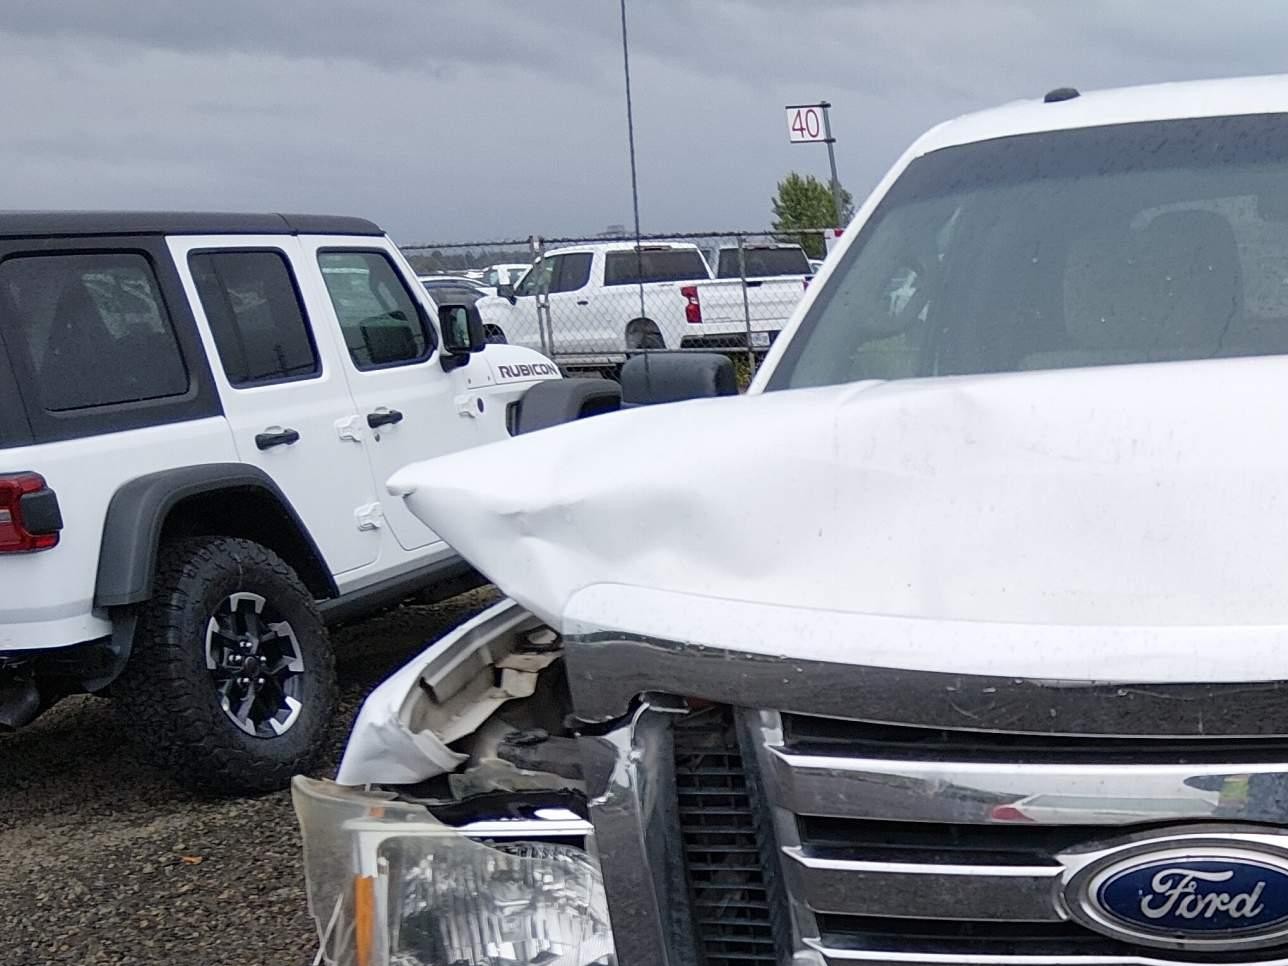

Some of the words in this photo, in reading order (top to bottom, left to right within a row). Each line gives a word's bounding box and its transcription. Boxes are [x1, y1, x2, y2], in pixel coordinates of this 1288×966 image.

[792, 109, 819, 138] 40
[498, 364, 558, 378] RUBICON
[1139, 867, 1266, 919] Ford
